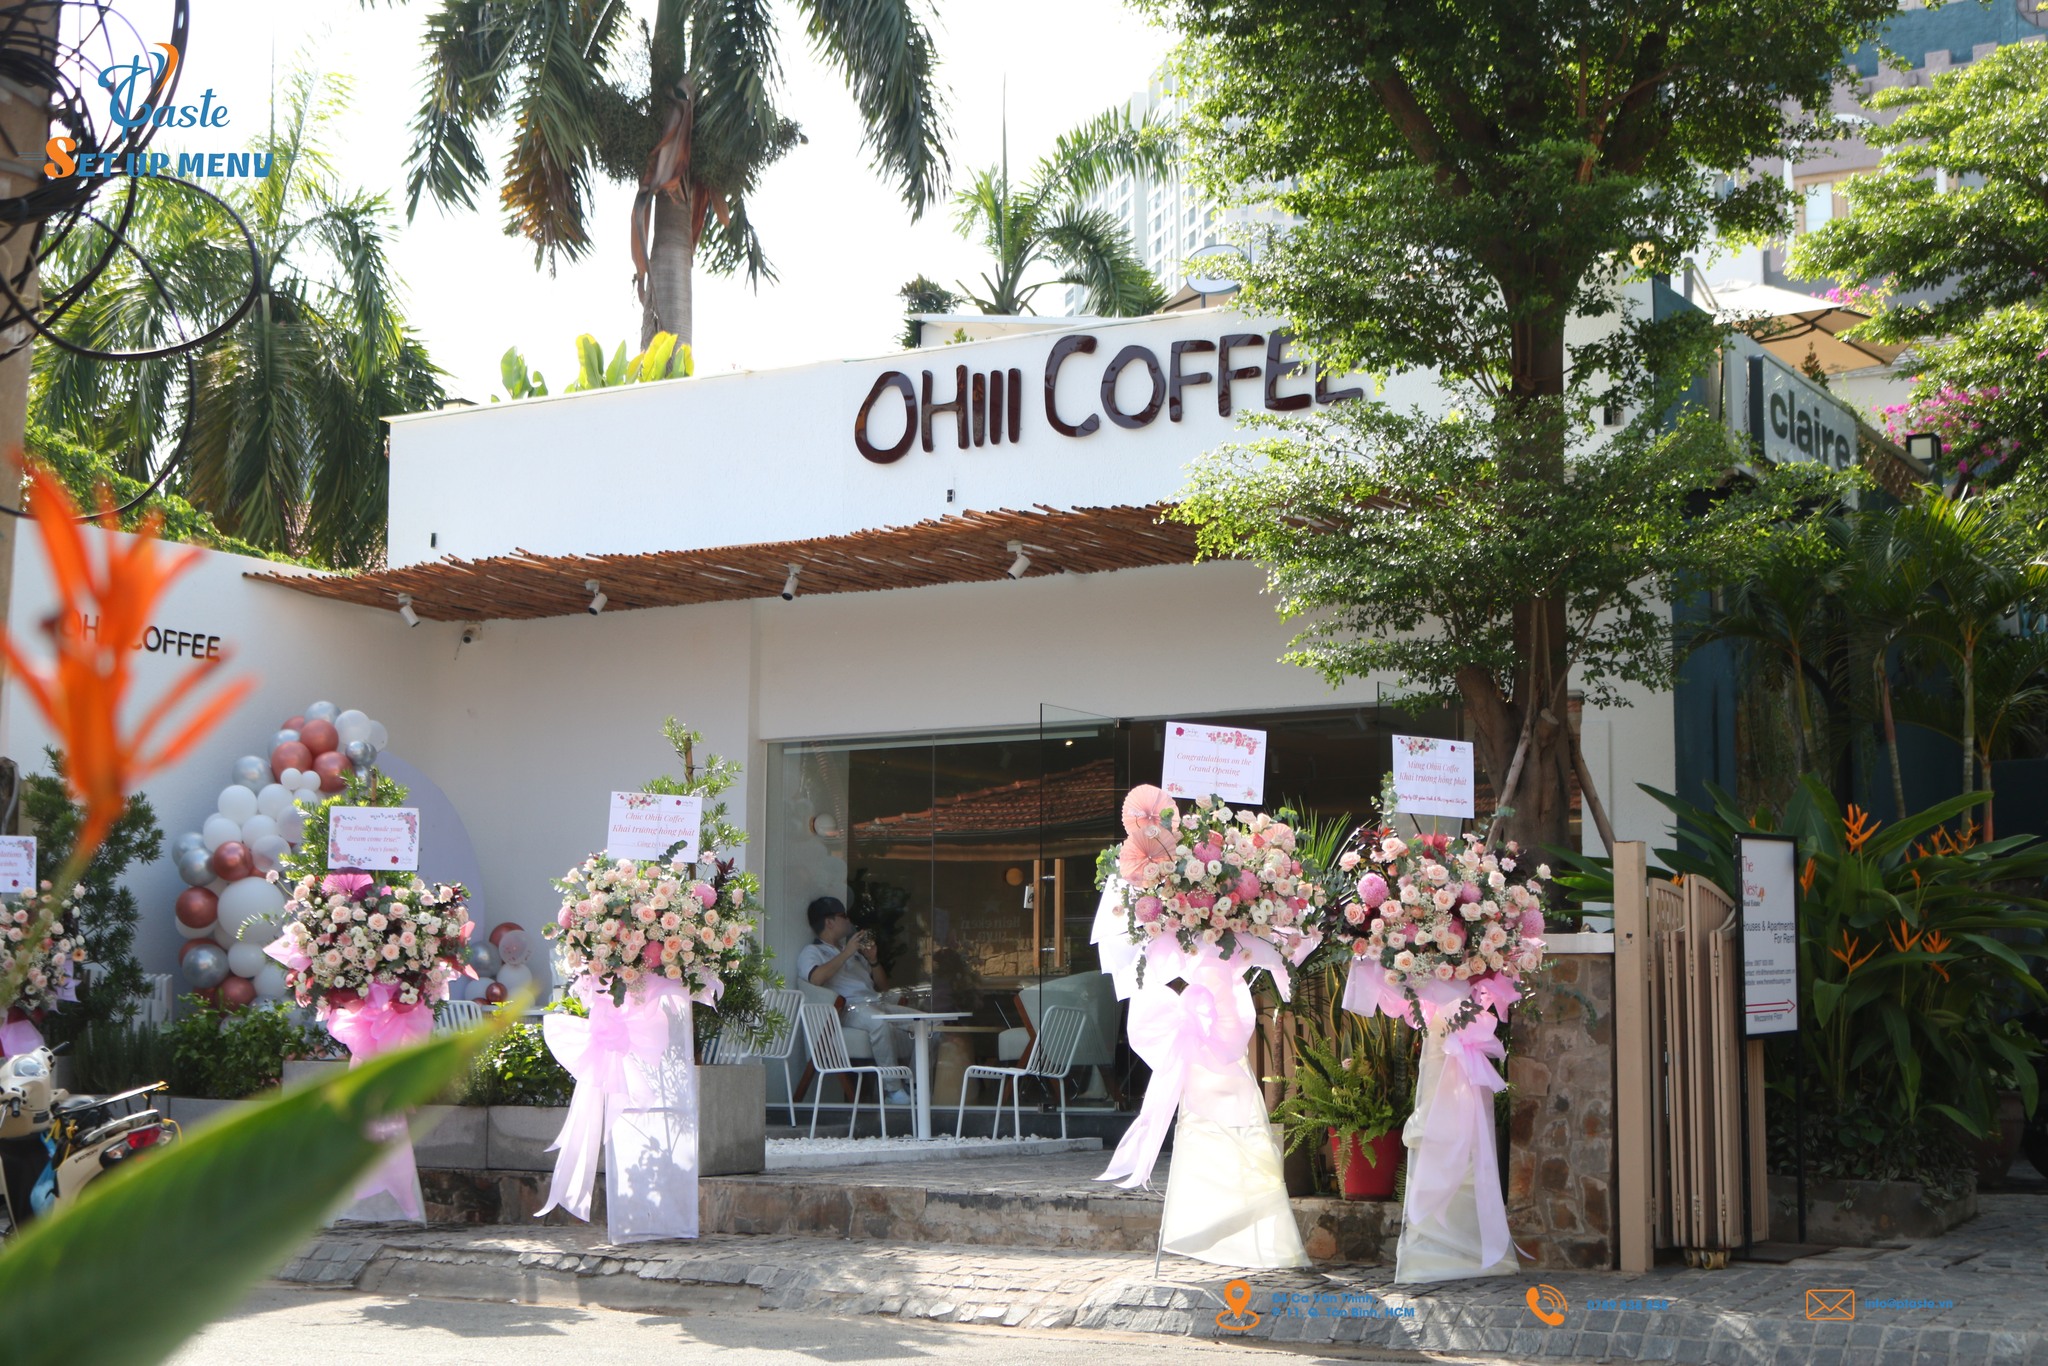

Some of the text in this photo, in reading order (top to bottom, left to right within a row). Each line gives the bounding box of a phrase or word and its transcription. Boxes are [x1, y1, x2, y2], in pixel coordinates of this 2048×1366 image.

[1770, 388, 1851, 474] claire
[130, 625, 221, 662] OFFEE
[1176, 752, 1230, 764] Congratulations
[1241, 757, 1252, 766] the
[1188, 765, 1241, 777] Grand Opening
[663, 814, 685, 824] Coffee
[1767, 920, 1794, 934] Apartments
[1774, 933, 1782, 944] For
